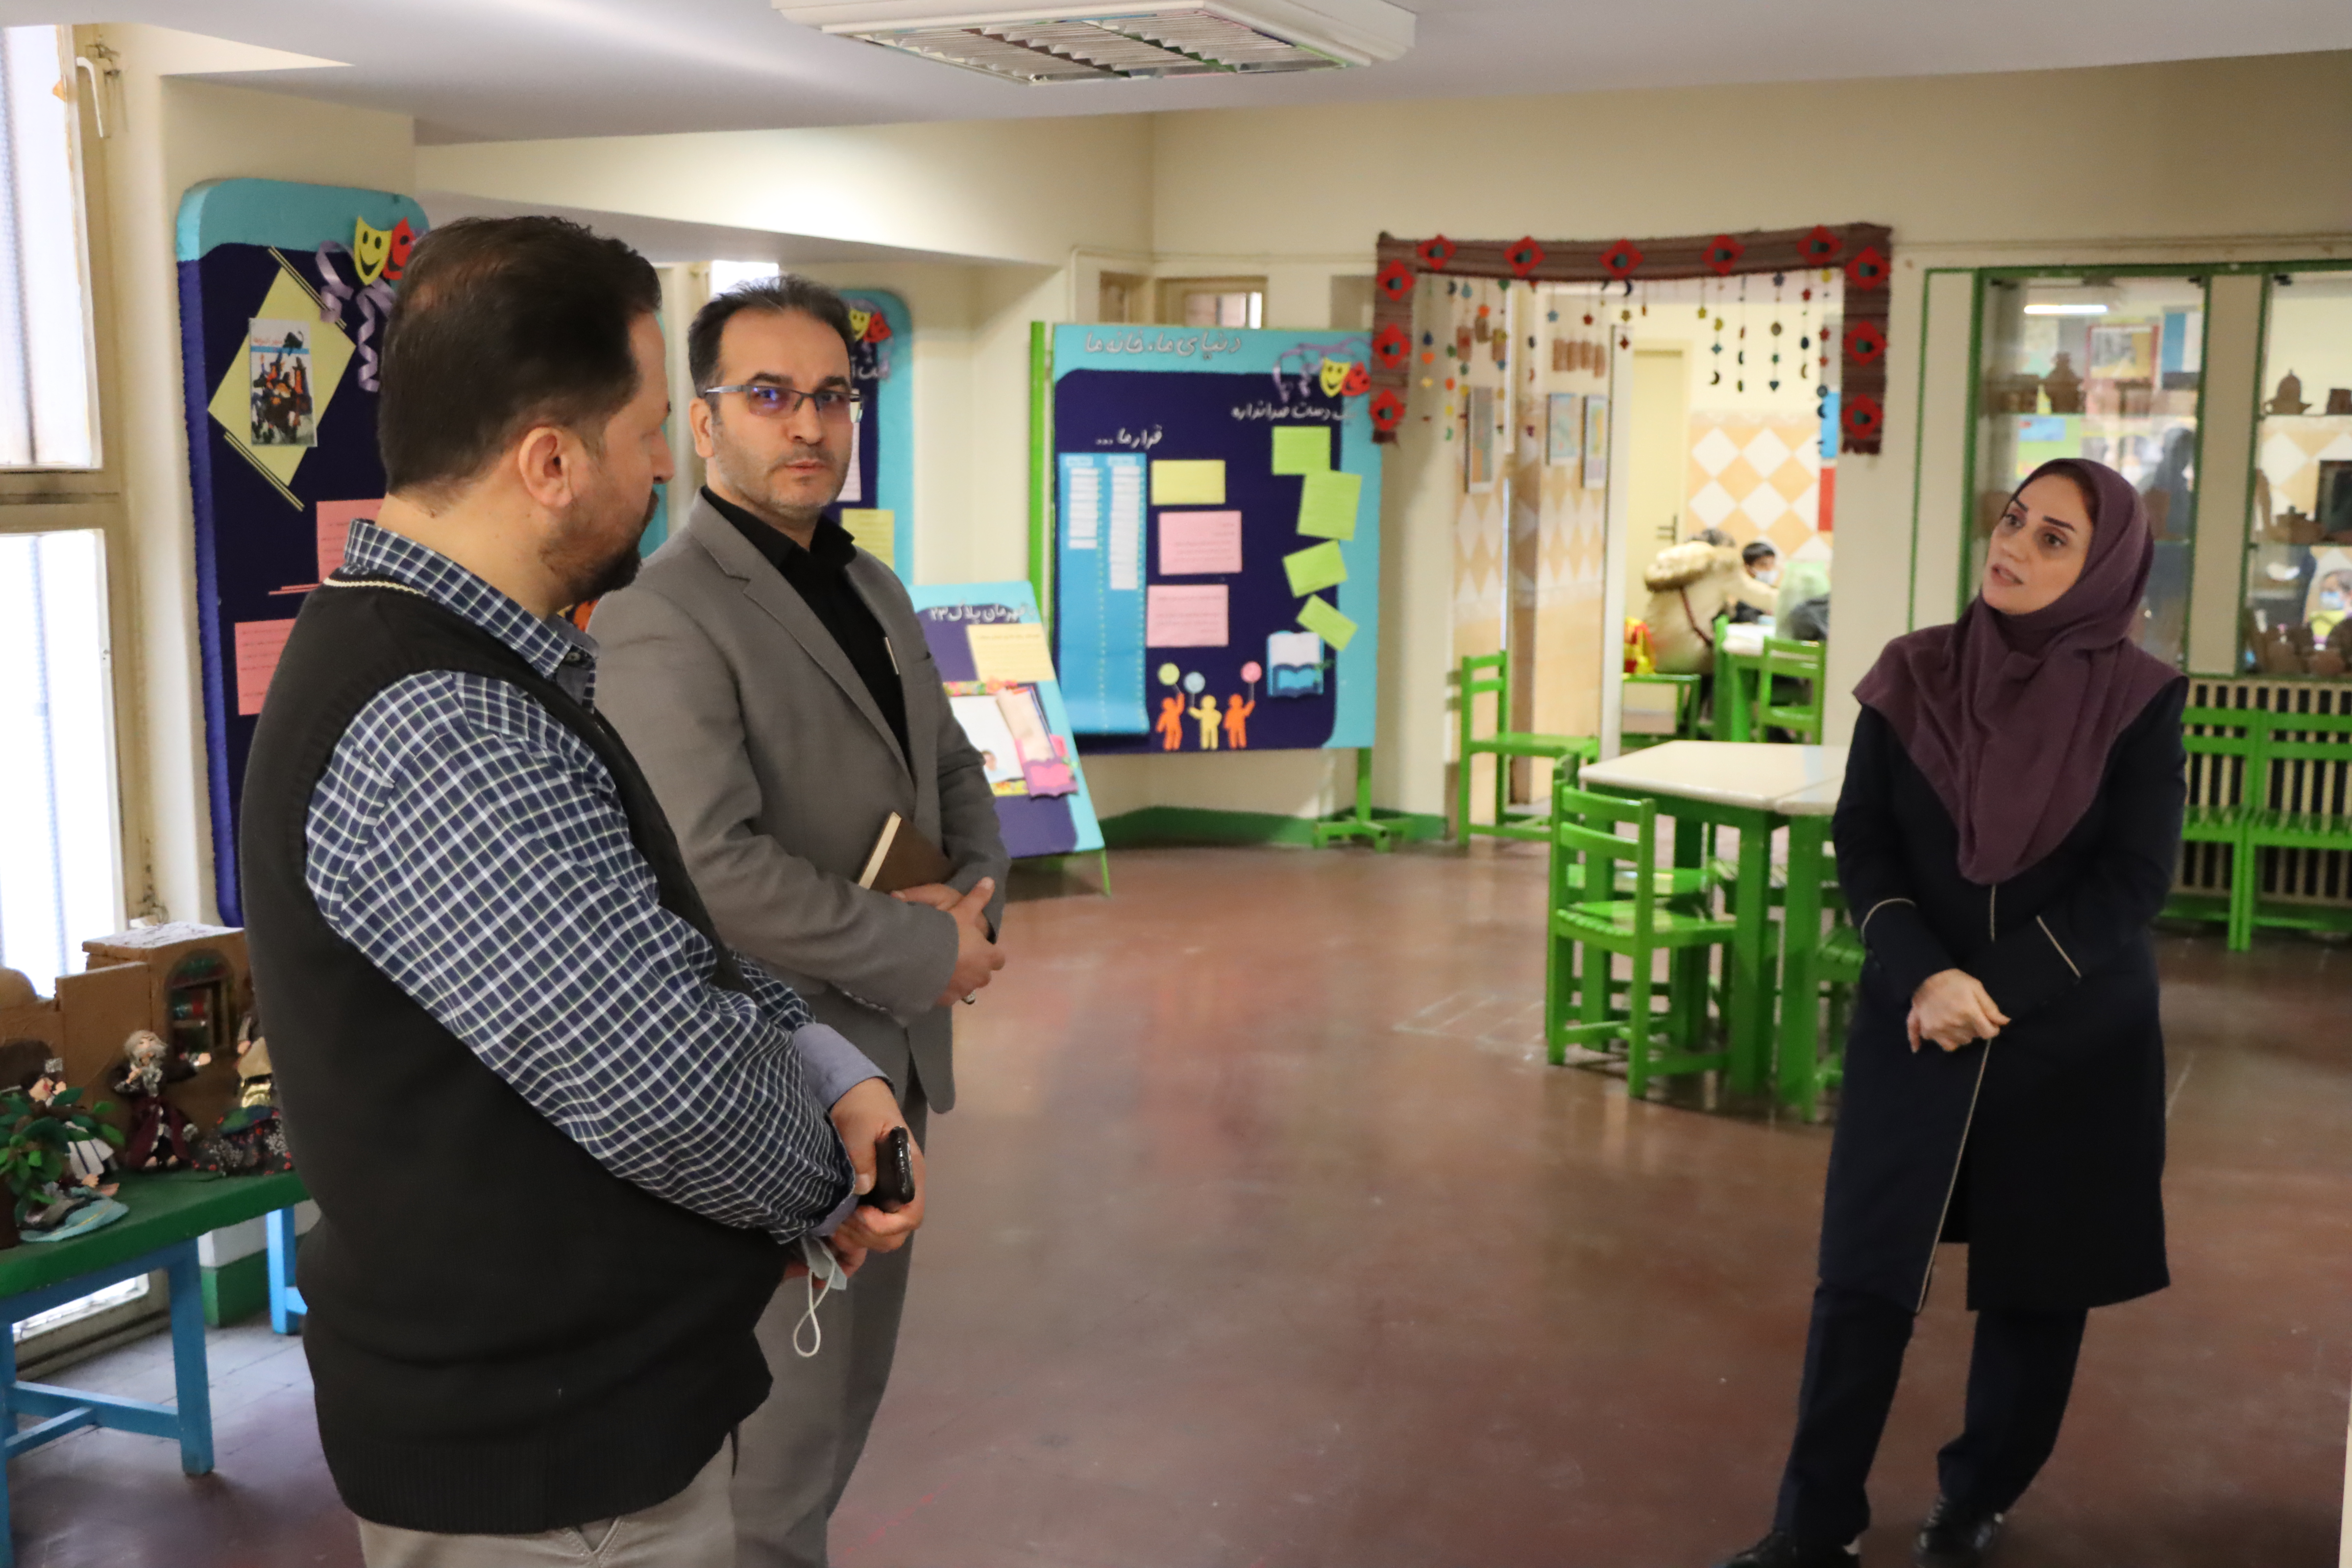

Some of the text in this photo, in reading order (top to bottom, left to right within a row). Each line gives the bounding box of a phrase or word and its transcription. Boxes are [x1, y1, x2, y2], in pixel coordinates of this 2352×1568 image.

[1084, 331, 1103, 353] ما
[1106, 329, 1144, 353] خانه
[1176, 329, 1241, 360] دنیای
